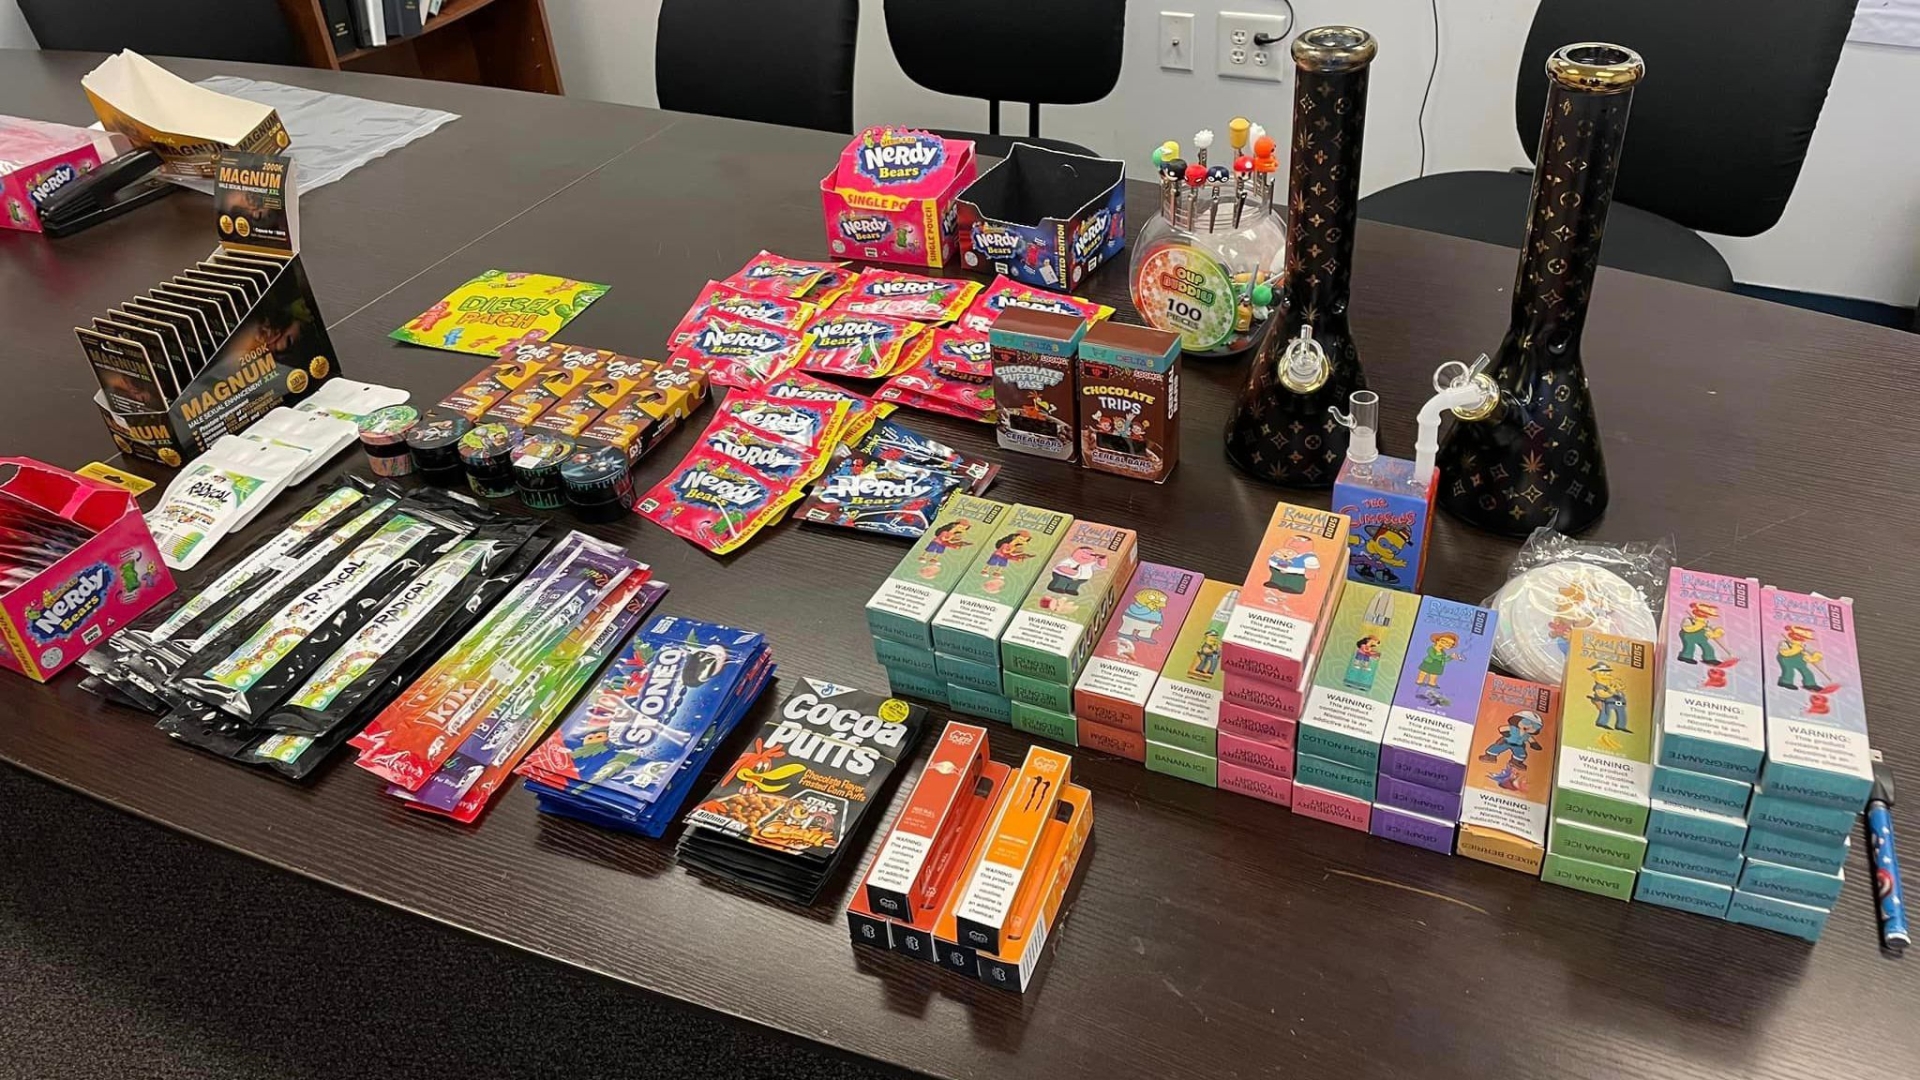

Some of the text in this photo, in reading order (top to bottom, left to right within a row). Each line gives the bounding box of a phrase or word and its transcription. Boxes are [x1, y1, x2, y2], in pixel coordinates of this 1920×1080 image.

[865, 142, 937, 170] NeRdy
[219, 167, 281, 189] MAGNUM
[879, 167, 919, 178] Bears
[848, 194, 889, 209] SINGLE
[843, 216, 887, 235] NeRdy
[925, 207, 937, 261] SINGLE POUCH
[1075, 215, 1107, 254] NeRdy
[855, 232, 881, 241] Bears
[976, 232, 1019, 249] NeRdy
[458, 295, 559, 316] DIESEL
[1167, 298, 1202, 321] 100
[456, 311, 537, 329] PATCH
[1166, 312, 1201, 331] PIECES
[240, 343, 269, 367] 2000K
[516, 344, 551, 358] Cake
[562, 351, 598, 365] Cake
[606, 361, 642, 375] Cake
[654, 370, 691, 385] Cake
[994, 365, 1065, 380] CHOCOLATE
[180, 352, 277, 421] MAGNUM
[1017, 381, 1045, 391] PASS
[1083, 386, 1155, 405] CHOCOLATE
[188, 371, 280, 429] MALE SEXUAL ENHANCEMENT XXL
[1098, 396, 1142, 415] TRIPS
[1005, 431, 1064, 448] CEREAL BARS
[1092, 450, 1152, 468] CEREAL BARS
[681, 471, 764, 505] NeRdy
[985, 505, 1002, 523] 5000
[1044, 516, 1061, 534] 5000
[1324, 517, 1339, 538] 5000
[1108, 532, 1125, 551] 5000
[895, 584, 930, 597] WARNING:
[1736, 583, 1747, 607] 5000
[35, 568, 104, 635] NeRdy
[374, 580, 433, 627] RADICAL
[960, 599, 997, 612] WARNING:
[60, 596, 99, 631] Bears
[1028, 616, 1068, 630] WARNING:
[1248, 612, 1296, 629] WARNING:
[1474, 612, 1485, 635] 5000
[1832, 606, 1843, 631] 5000
[1633, 644, 1643, 668] 5000
[1100, 663, 1141, 677] WARNING:
[626, 647, 682, 745] STONEO
[1170, 684, 1214, 700] WARNING:
[1327, 693, 1375, 711] WARNING:
[1538, 689, 1548, 713] 5000
[424, 682, 475, 724] KIK
[1684, 698, 1744, 715] WARNING:
[783, 693, 908, 748] Cocoa
[1406, 713, 1456, 731] WARNING:
[1154, 724, 1207, 743] BANANA ICE
[1788, 726, 1850, 742] WARNING:
[1302, 734, 1376, 759] COTTON PEARS
[1155, 754, 1208, 774] BANANA ICE
[1578, 754, 1634, 772] WARNING:
[1669, 751, 1758, 774] POMEGRANATE
[804, 769, 867, 792] Chocolate Flavor
[1300, 765, 1373, 788] COTTON PEARS
[799, 776, 867, 802] Frosted Corn Puffs
[1659, 784, 1745, 809] POMEGRANATE
[806, 796, 837, 809] STAR
[1480, 794, 1530, 811] WARNING:
[1566, 803, 1634, 825] BANANA ICE
[1759, 812, 1849, 837] POMEGRANATE
[1655, 826, 1741, 849] POMEGRANATE
[1564, 839, 1631, 860] BANANA ICE
[1753, 843, 1842, 866] POMEGRANATE
[1506, 854, 1539, 867] MIXED
[1652, 856, 1737, 879] POMEGRANATE
[1575, 874, 1620, 890] BANANA
[1643, 887, 1725, 911] POMEGRANATE
[1733, 901, 1818, 928] POMEGRANATE
